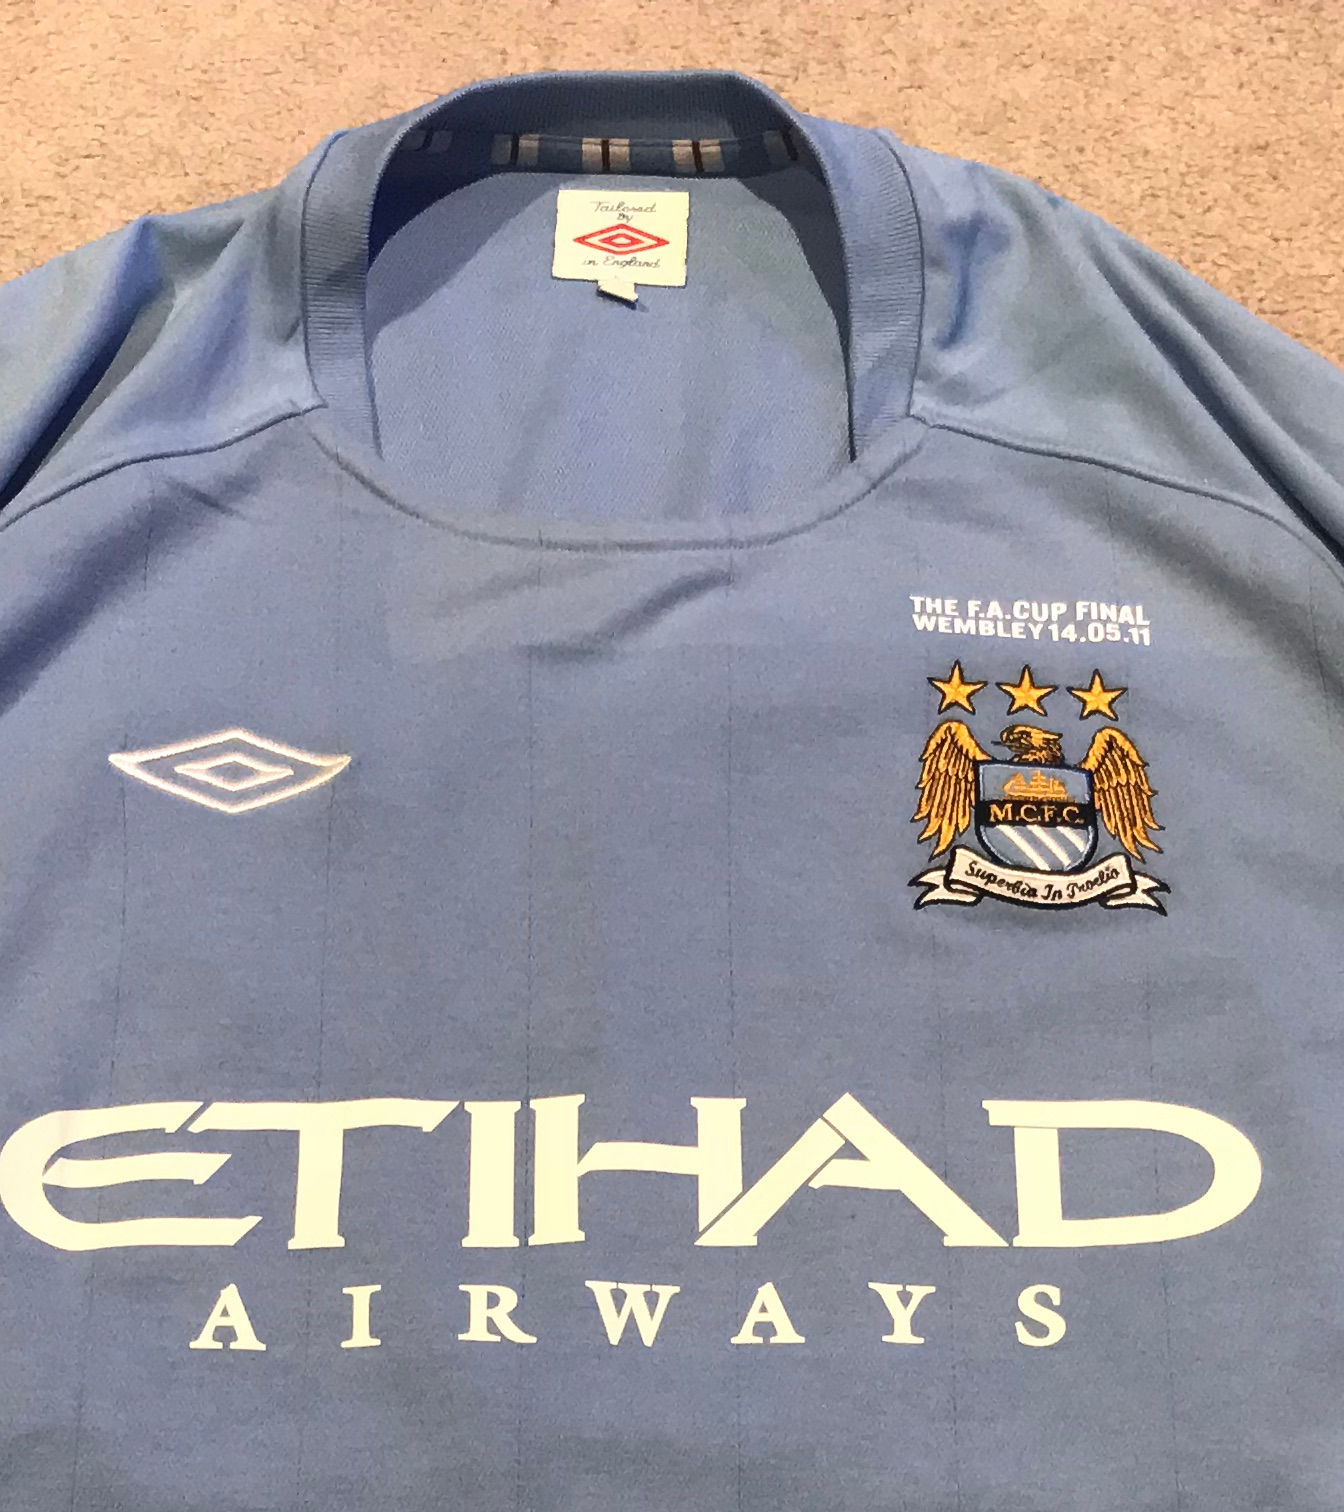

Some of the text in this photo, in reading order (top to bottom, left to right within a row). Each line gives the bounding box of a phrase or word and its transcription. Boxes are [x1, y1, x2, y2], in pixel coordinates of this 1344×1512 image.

[590, 201, 657, 213] Tailored
[582, 256, 661, 268] in England
[909, 594, 959, 616] THE
[1076, 600, 1151, 626] FINAL
[965, 861, 1120, 900] Superbia In Proelio
[189, 1281, 1067, 1351] AIRWAYS
